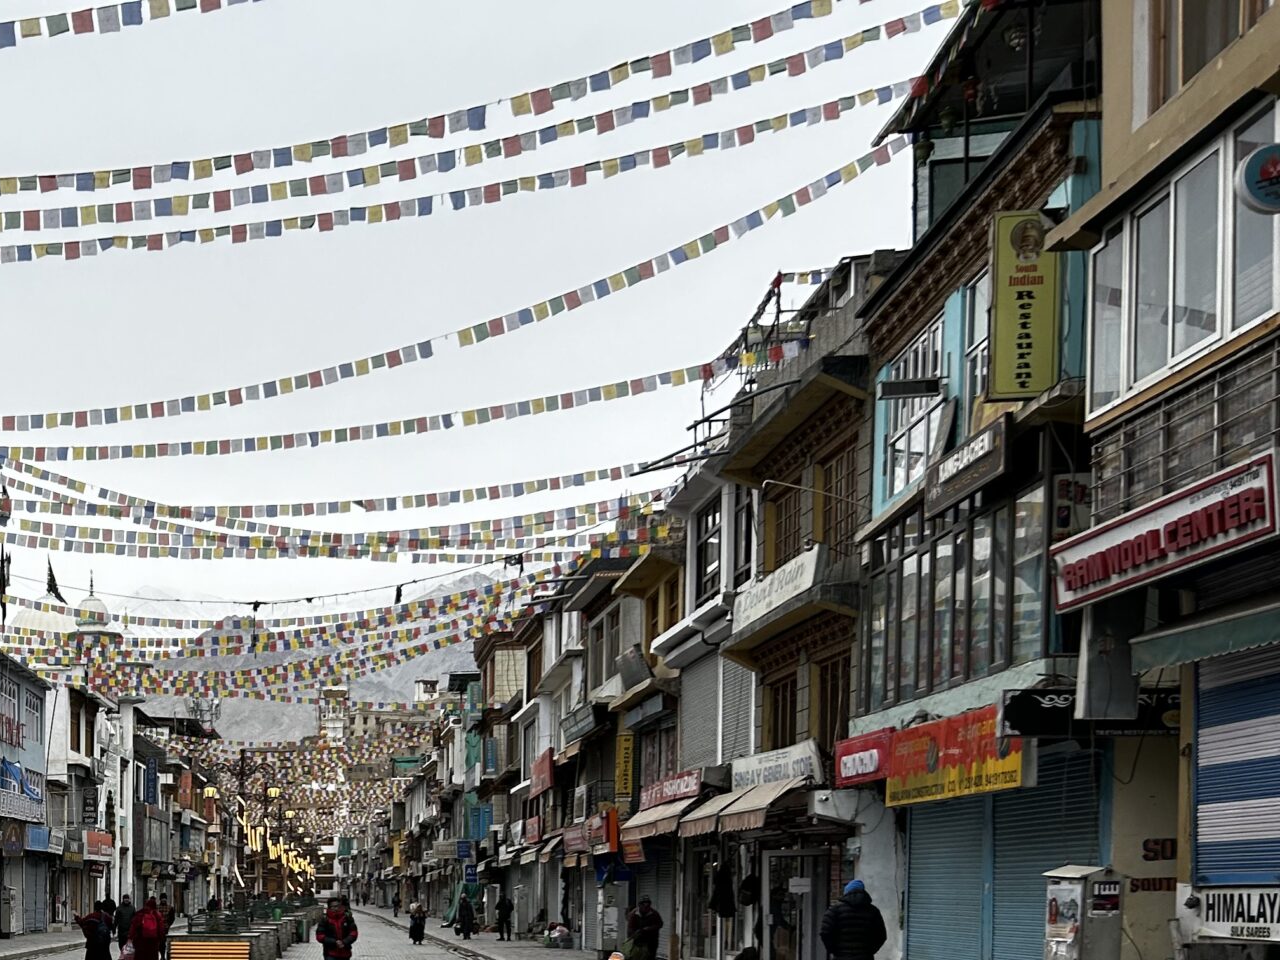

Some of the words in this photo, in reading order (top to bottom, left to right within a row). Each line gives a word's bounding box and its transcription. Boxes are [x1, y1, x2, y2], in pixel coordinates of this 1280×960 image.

[1015, 263, 1038, 274] South
[1008, 274, 1044, 287] Indian
[1015, 290, 1036, 389] Restaurant
[1062, 552, 1111, 592] RAM
[1105, 529, 1166, 575] WOOL
[1163, 487, 1266, 554] CENTER
[1231, 926, 1246, 938] SILK
[1246, 926, 1271, 938] SAREES
